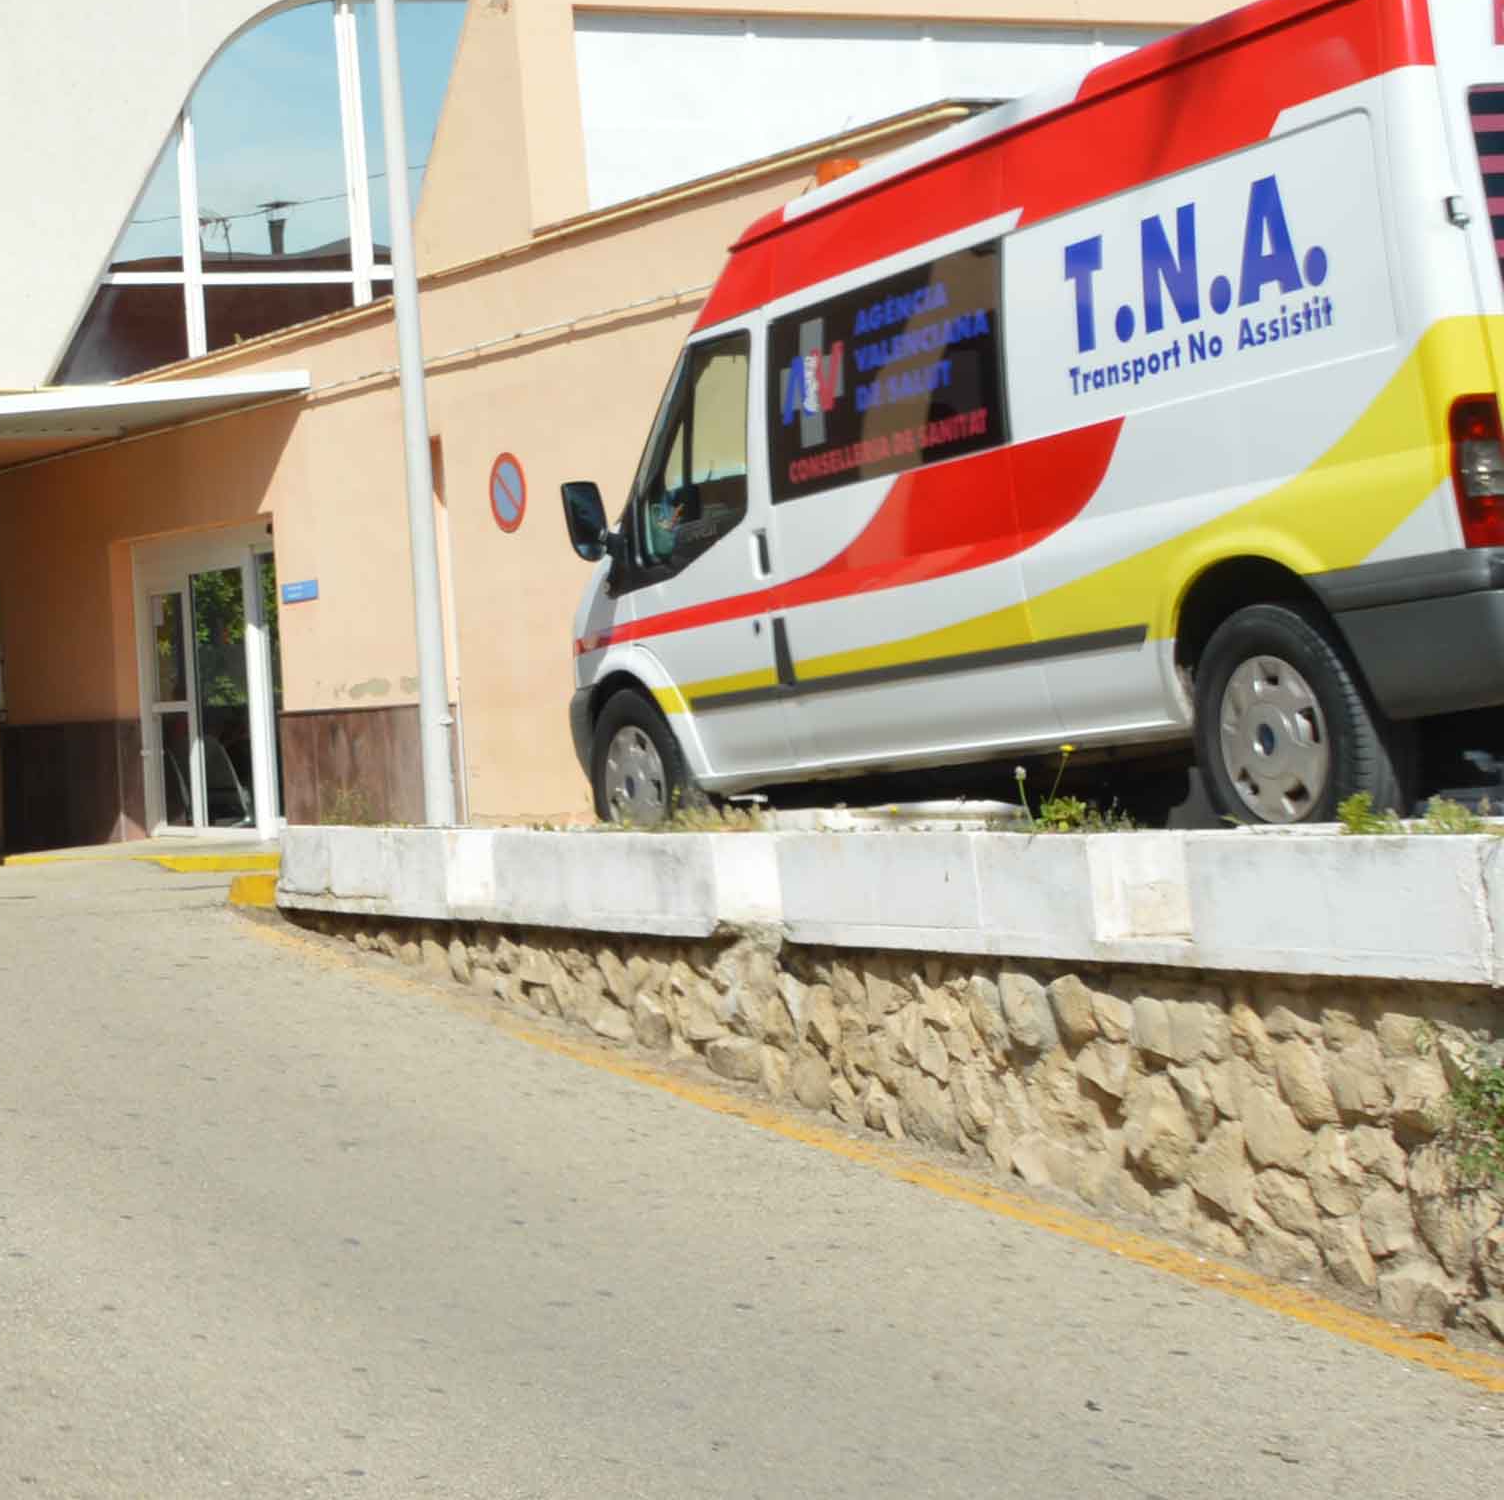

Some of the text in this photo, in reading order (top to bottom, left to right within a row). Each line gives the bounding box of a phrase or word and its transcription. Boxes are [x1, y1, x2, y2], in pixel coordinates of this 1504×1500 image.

[1063, 174, 1329, 354] T.N.A.
[855, 308, 990, 372] VALENCIANA
[1069, 296, 1334, 396] Transport No Assistit
[855, 382, 881, 413] DE
[886, 360, 952, 403] SALUT
[894, 429, 916, 456] DE
[920, 408, 988, 448] SANITAT
